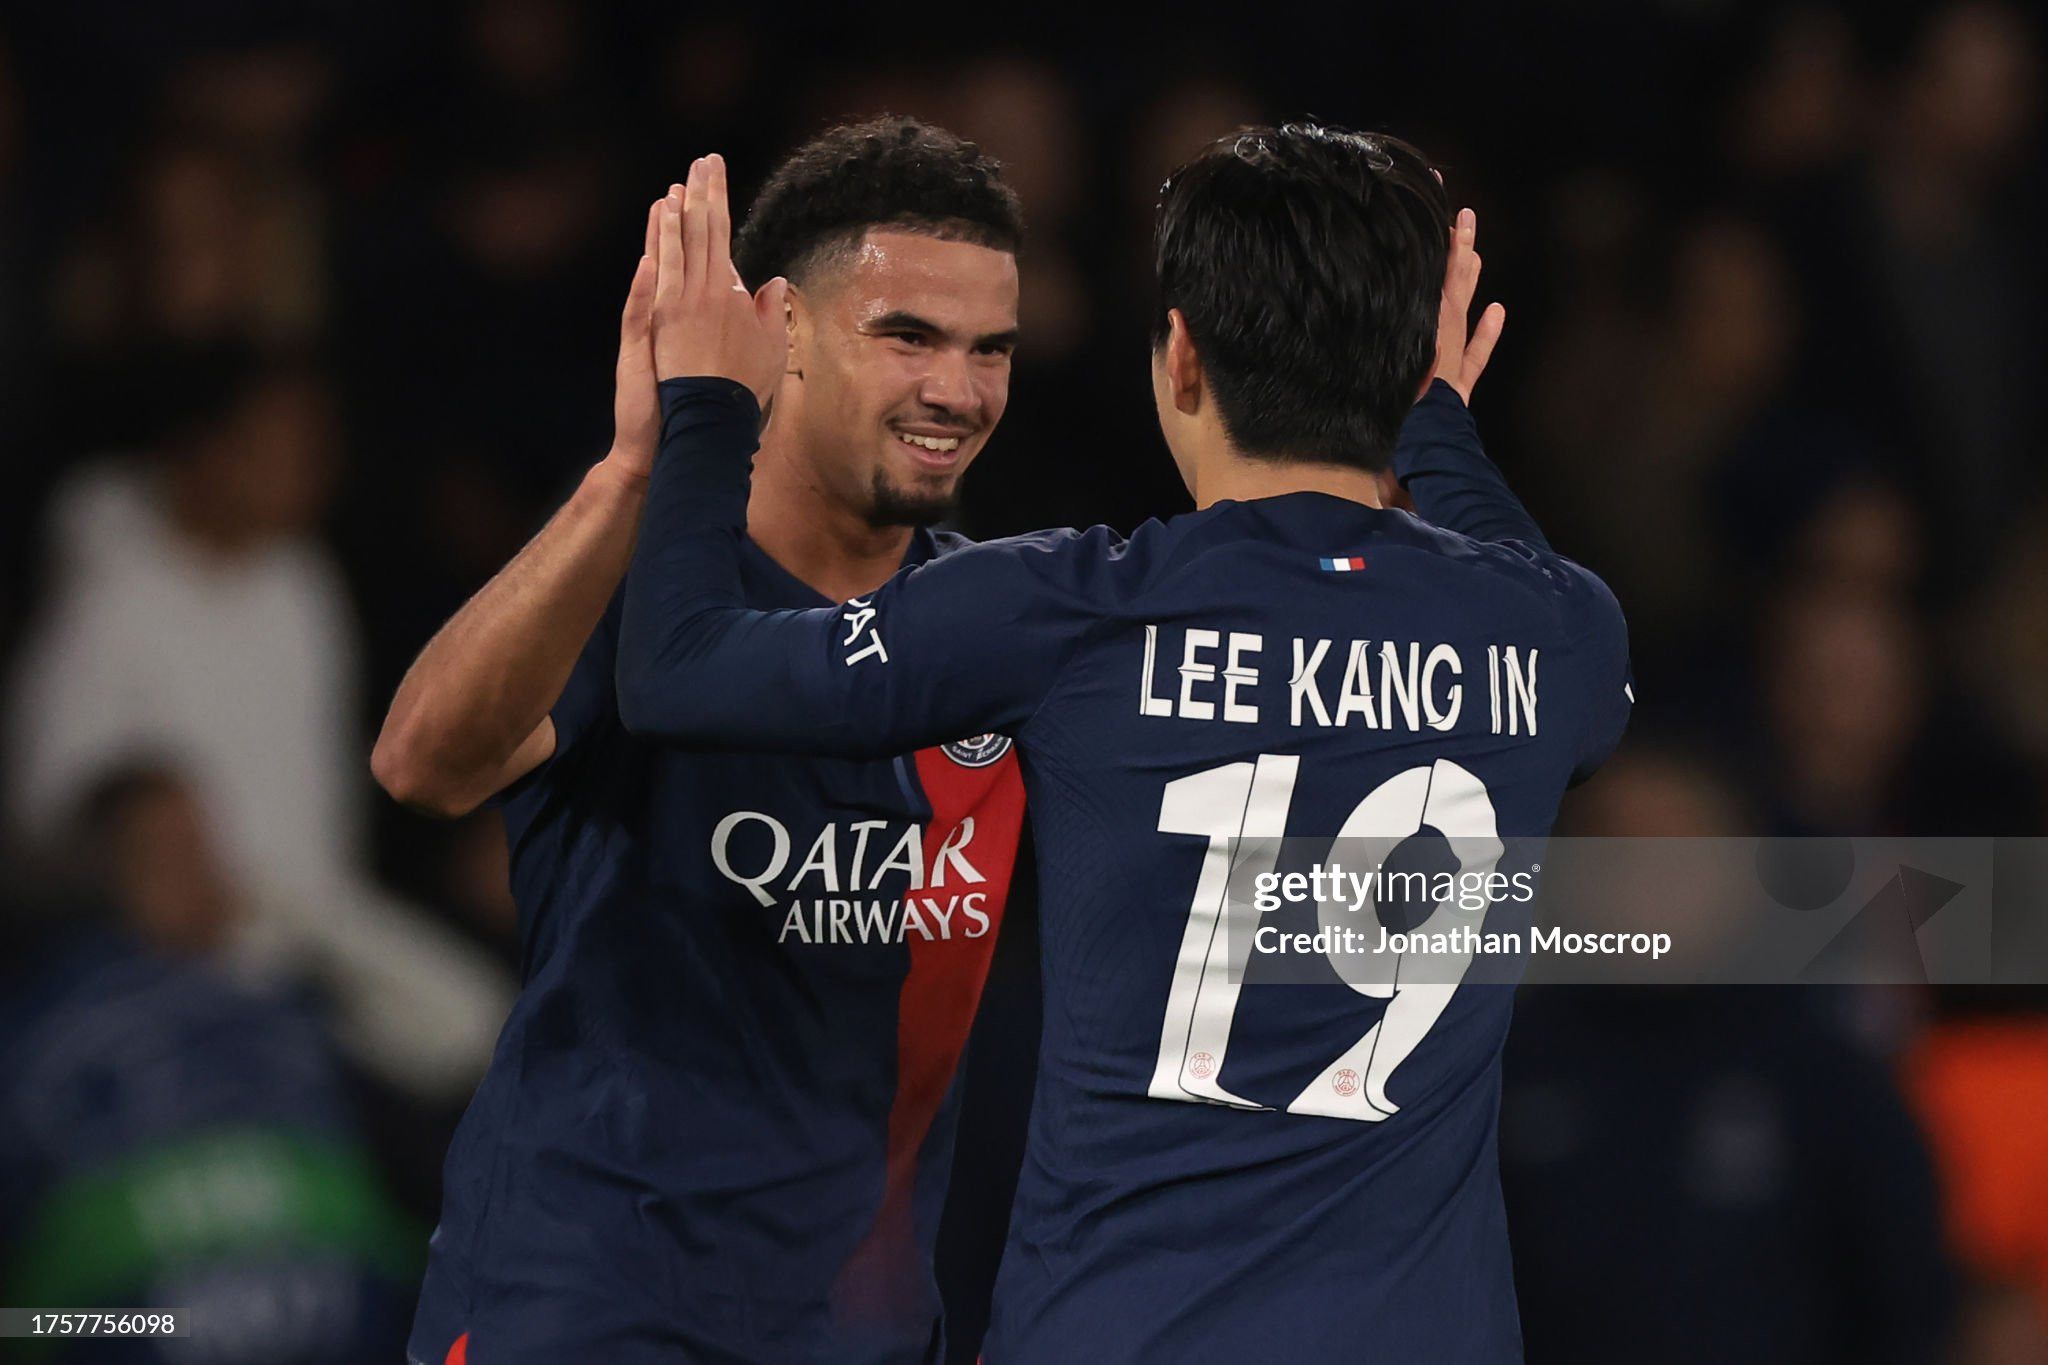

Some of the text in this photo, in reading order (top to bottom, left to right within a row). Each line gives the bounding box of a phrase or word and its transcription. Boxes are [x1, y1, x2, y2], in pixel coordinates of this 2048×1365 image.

[1139, 625, 1539, 736] LEE KANG IN
[711, 811, 986, 907] QATAR
[778, 892, 990, 944] AIRWAYS
[1147, 753, 1505, 1122] 19
